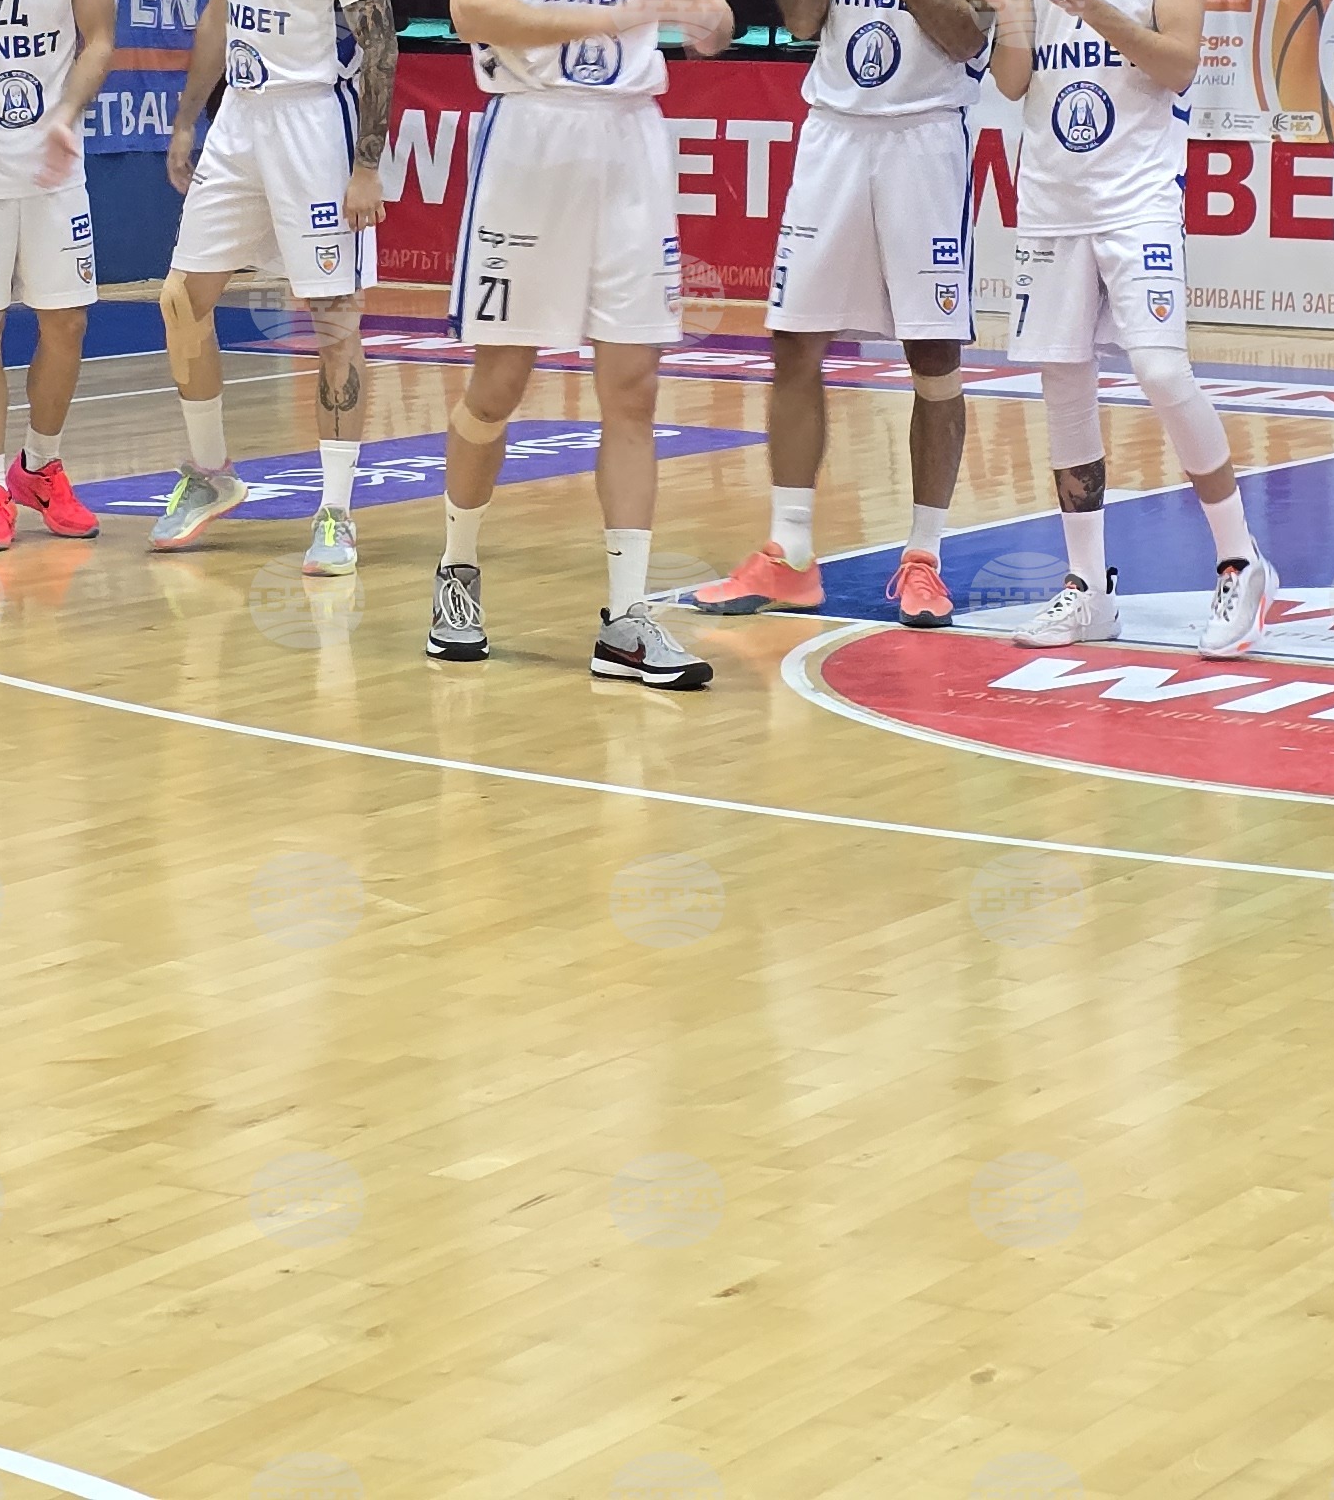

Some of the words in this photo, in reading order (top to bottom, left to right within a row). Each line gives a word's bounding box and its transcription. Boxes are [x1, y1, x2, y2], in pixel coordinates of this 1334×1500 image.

[228, 1, 291, 36] NBET
[1033, 41, 1137, 72] WINBE
[476, 275, 511, 322] 21
[1015, 293, 1030, 338] 7
[1271, 290, 1298, 312] НА
[939, 688, 1147, 717] ХАЗАРТЪТ
[1150, 710, 1253, 730] НОСИ
